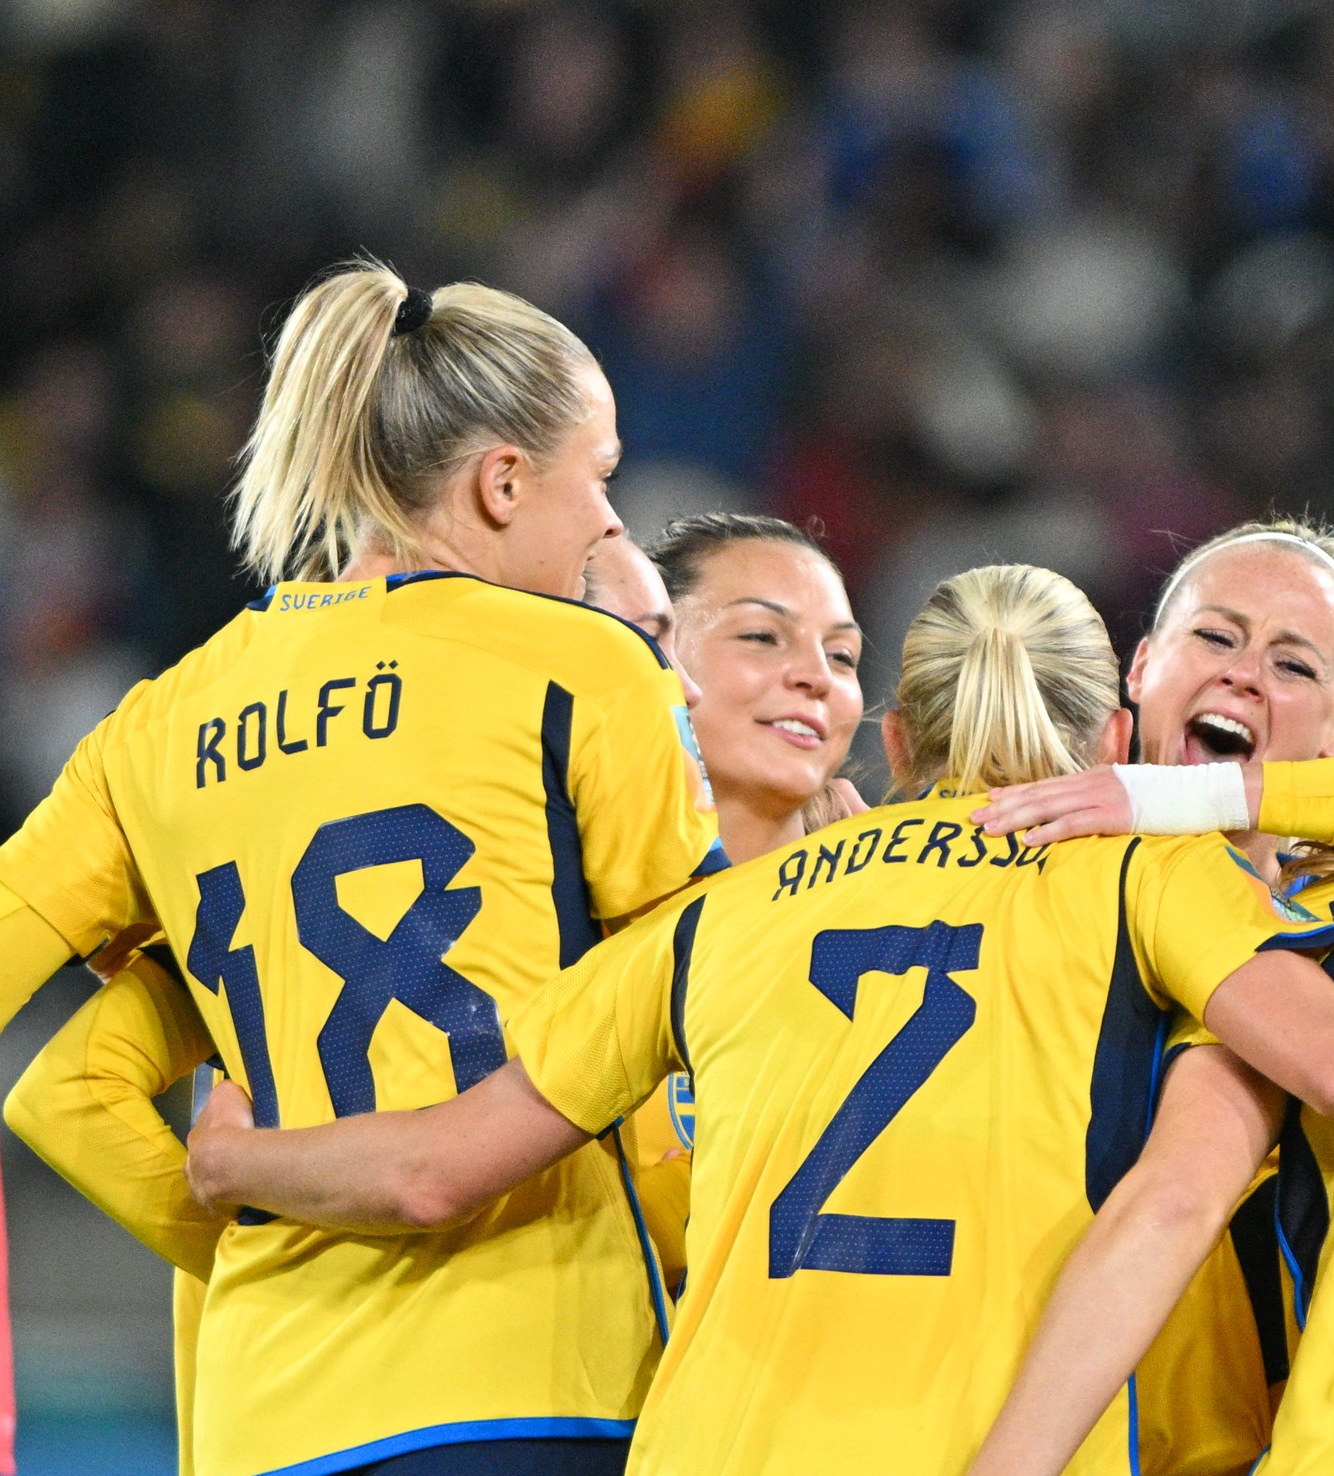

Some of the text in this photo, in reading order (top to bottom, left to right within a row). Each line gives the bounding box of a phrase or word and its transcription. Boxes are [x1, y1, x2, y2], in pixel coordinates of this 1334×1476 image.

[280, 586, 372, 612] SVERIGE
[195, 660, 402, 789] ROLFÖ
[771, 818, 1051, 903] ANDERSSO
[187, 803, 508, 1226] 18
[768, 919, 985, 1279] 2
